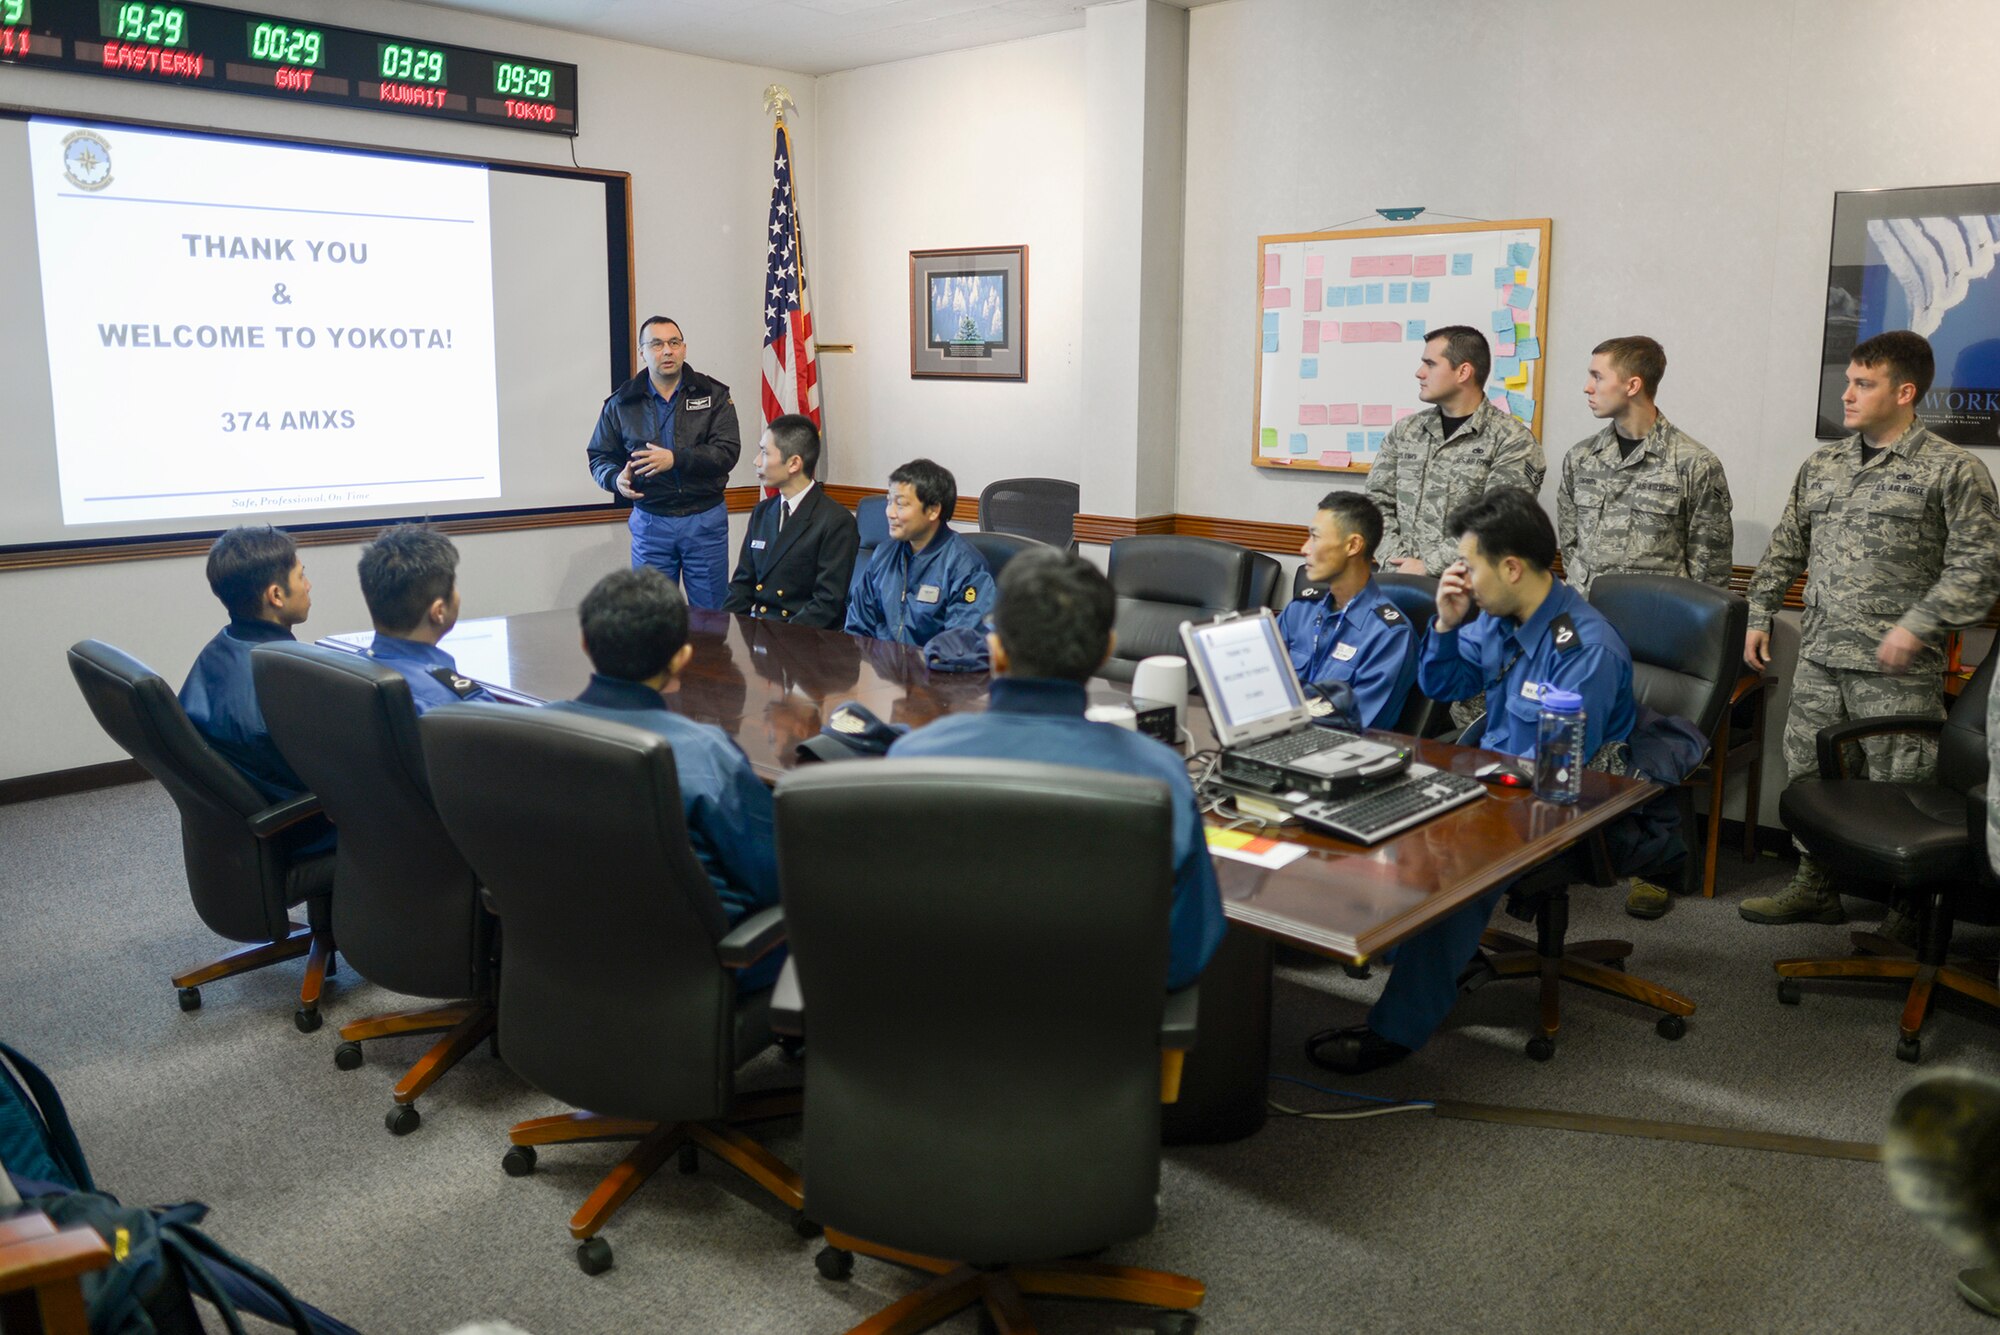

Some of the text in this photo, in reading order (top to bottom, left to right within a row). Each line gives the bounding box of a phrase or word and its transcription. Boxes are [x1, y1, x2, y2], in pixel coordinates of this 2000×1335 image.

[252, 22, 322, 67] 00:29
[103, 40, 204, 79] EASTERN
[274, 66, 316, 92] GMT
[379, 80, 447, 109] KUWAIT
[504, 99, 557, 123] TOKYO
[181, 233, 368, 265] THANK YOU
[271, 282, 293, 305] &
[97, 323, 453, 350] WELCOME TO YOKOTA!
[221, 409, 356, 433] 374 AMXS
[1887, 484, 1902, 492] AIR
[1902, 485, 1925, 496] FORCE
[231, 498, 258, 509] Safe,
